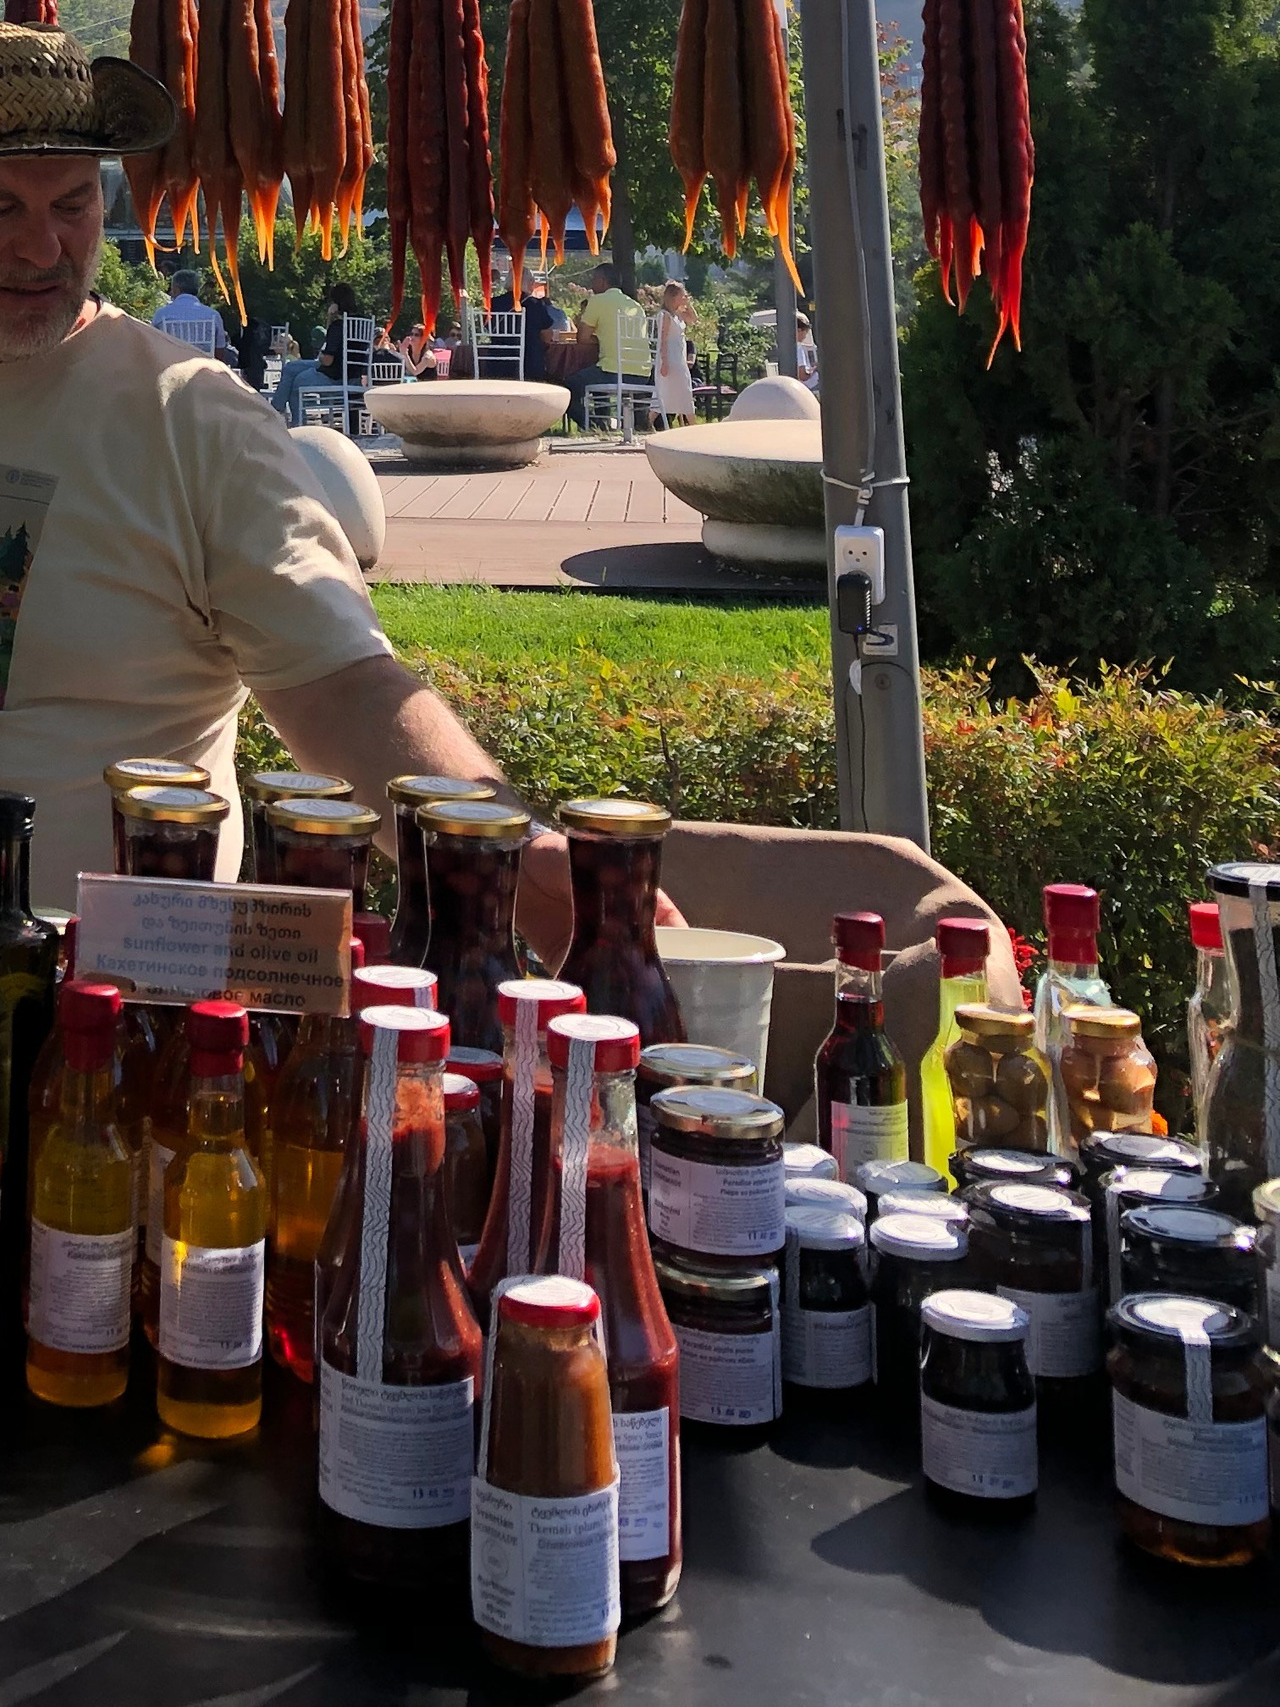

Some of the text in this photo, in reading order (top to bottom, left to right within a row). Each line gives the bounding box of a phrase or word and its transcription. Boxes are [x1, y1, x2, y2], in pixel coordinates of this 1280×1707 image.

[141, 915, 165, 931] და
[256, 922, 302, 943] ზეთი
[123, 937, 319, 965] sunflower and olive oil
[96, 954, 344, 989] Кахетинское подсолнечное
[249, 991, 307, 1009] масло
